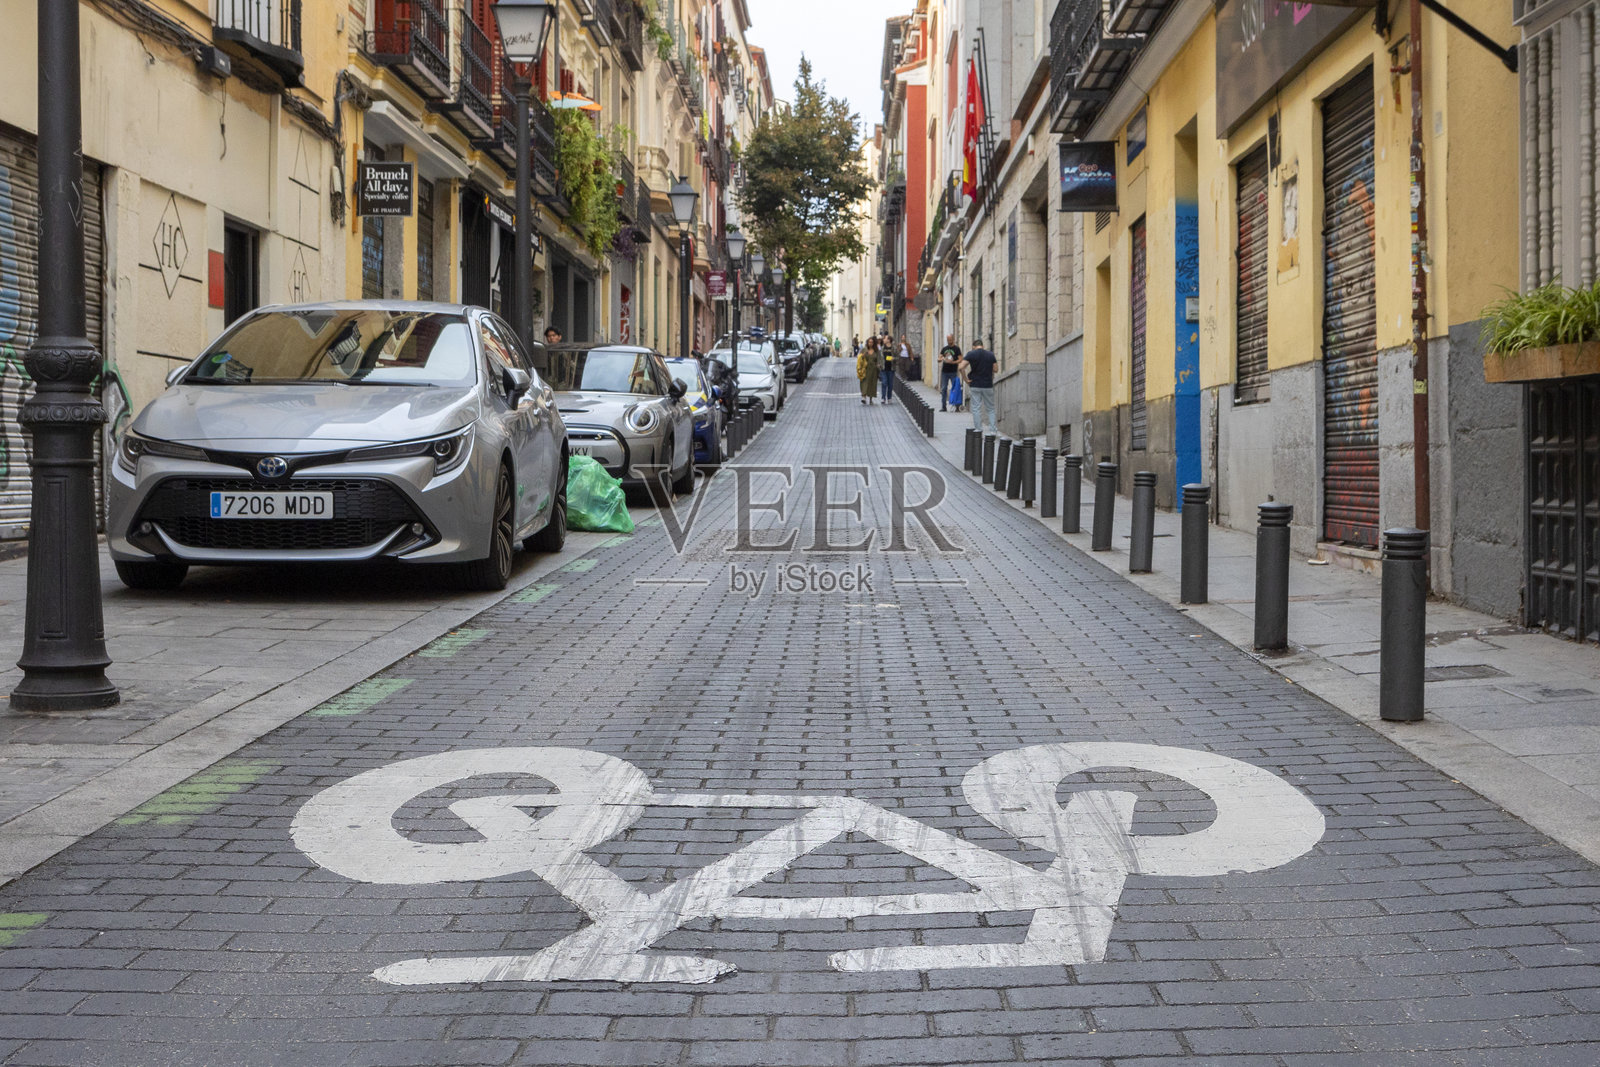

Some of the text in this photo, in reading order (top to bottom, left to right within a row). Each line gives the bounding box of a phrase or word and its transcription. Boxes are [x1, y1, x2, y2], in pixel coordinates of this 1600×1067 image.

[366, 167, 408, 180] Brunch
[365, 180, 381, 192] All
[382, 180, 402, 193] day
[364, 193, 390, 202] Specialty
[161, 222, 183, 270] HC
[224, 496, 275, 515] 7206
[285, 496, 325, 515] MDD
